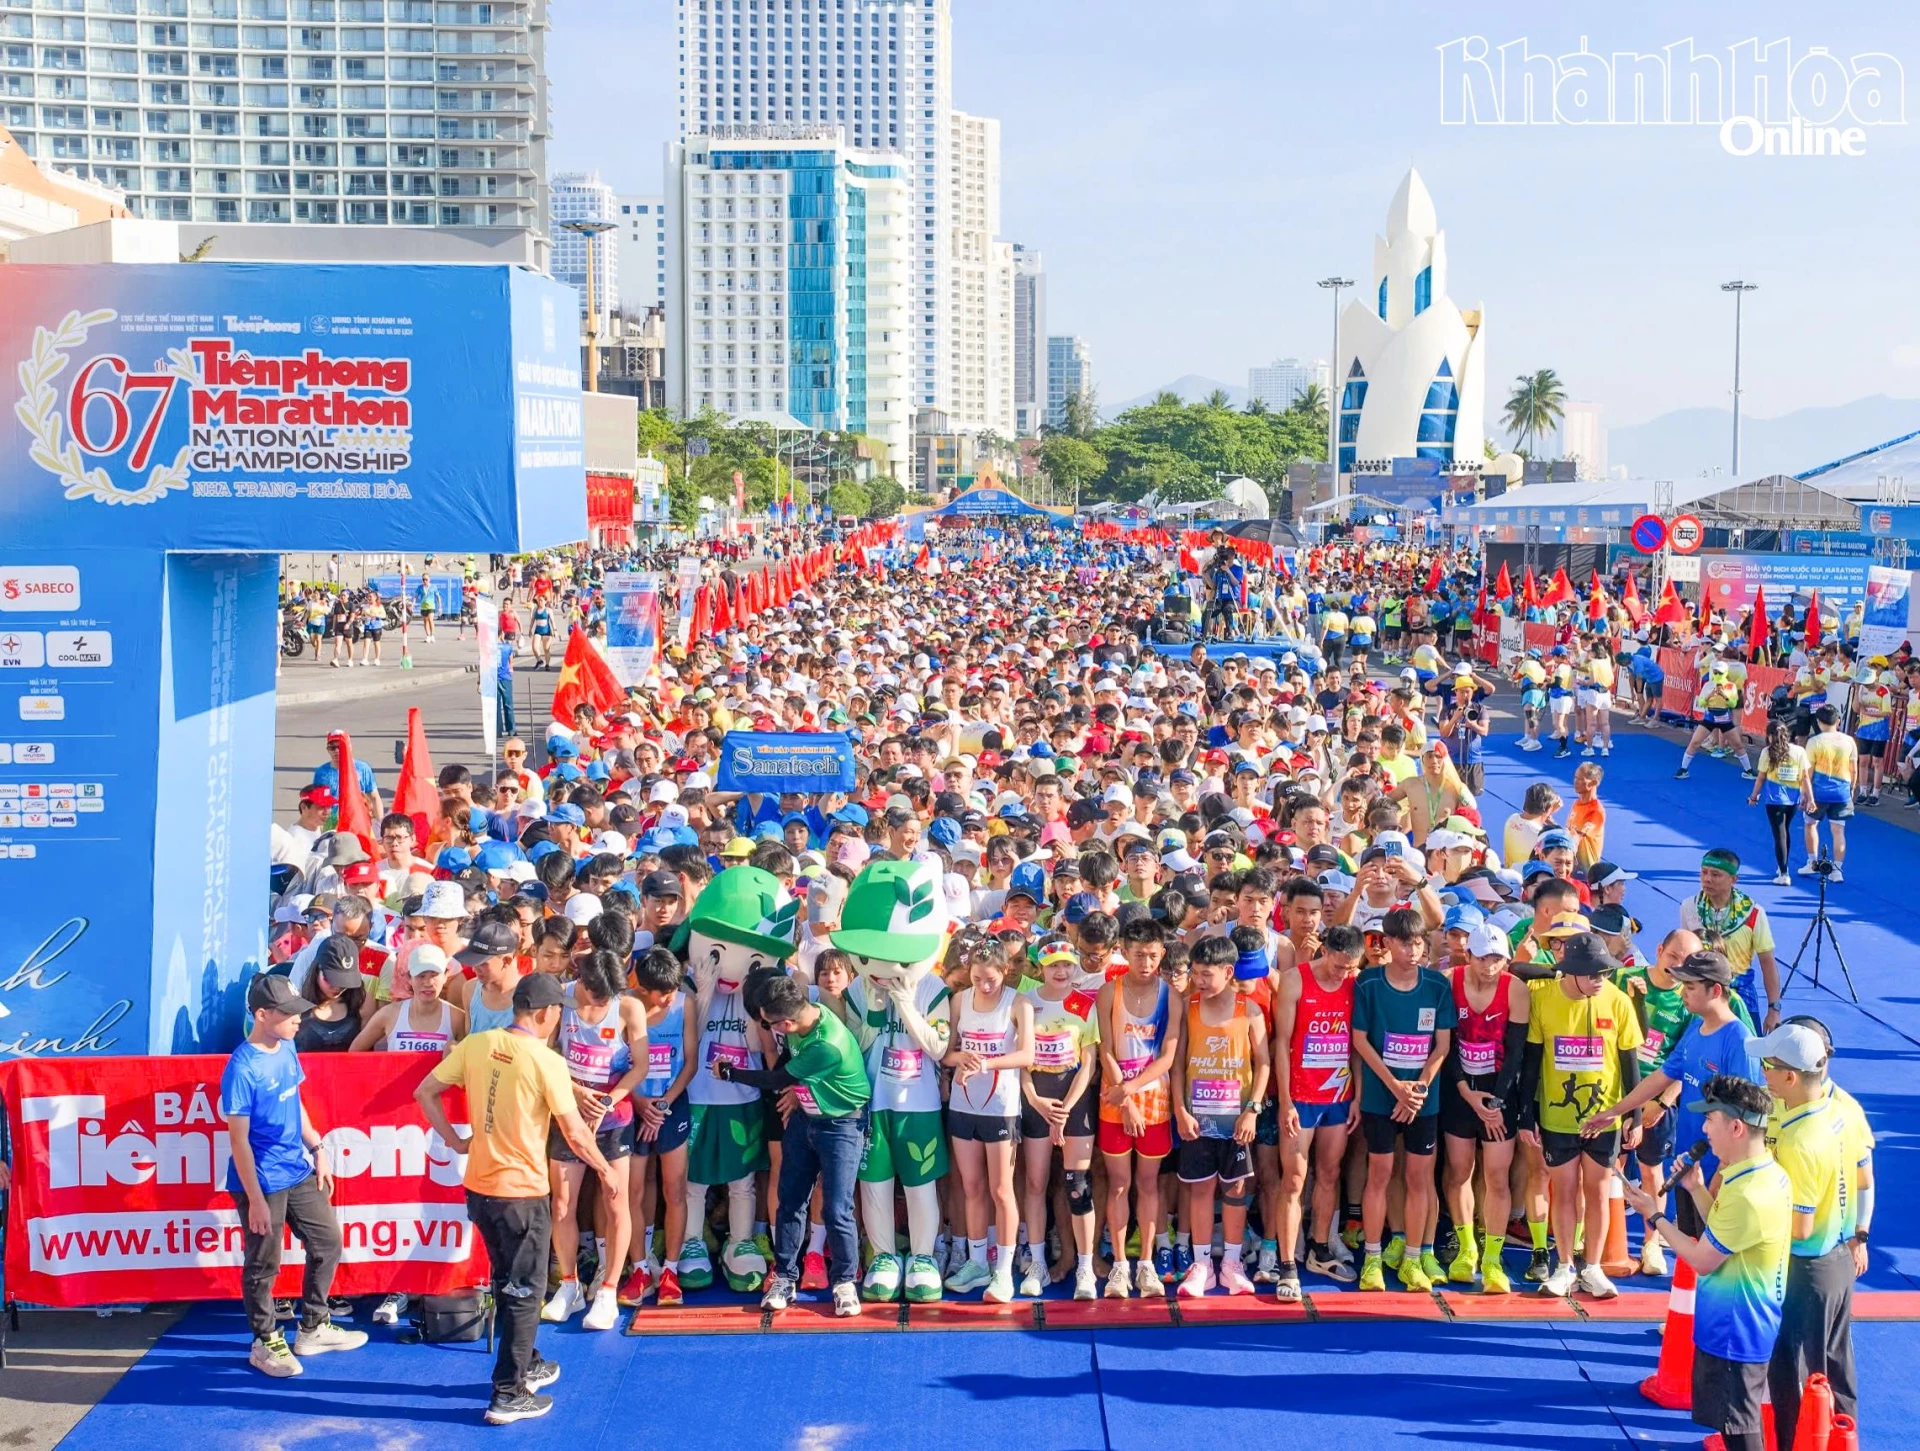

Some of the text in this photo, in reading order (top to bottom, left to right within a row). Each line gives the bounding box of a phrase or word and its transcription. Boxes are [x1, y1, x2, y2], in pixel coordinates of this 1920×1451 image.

[191, 391, 409, 426] Marathon
[520, 397, 581, 437] MARATHON
[193, 429, 334, 447] NATIONAL
[193, 452, 408, 470] CHAMPIONSHIP
[25, 582, 74, 594] SABECO
[732, 747, 841, 777] Sanatech
[399, 1040, 438, 1051] 51668
[964, 1040, 998, 1051] 52118
[1306, 1042, 1340, 1053] 50130
[1387, 1041, 1422, 1054] 50371
[569, 1049, 603, 1067] 50716
[1198, 1069, 1236, 1077] RUNNERS
[484, 1068, 501, 1135] REFEREE
[1195, 1088, 1234, 1100] 50275
[155, 1083, 230, 1125] BÁ
